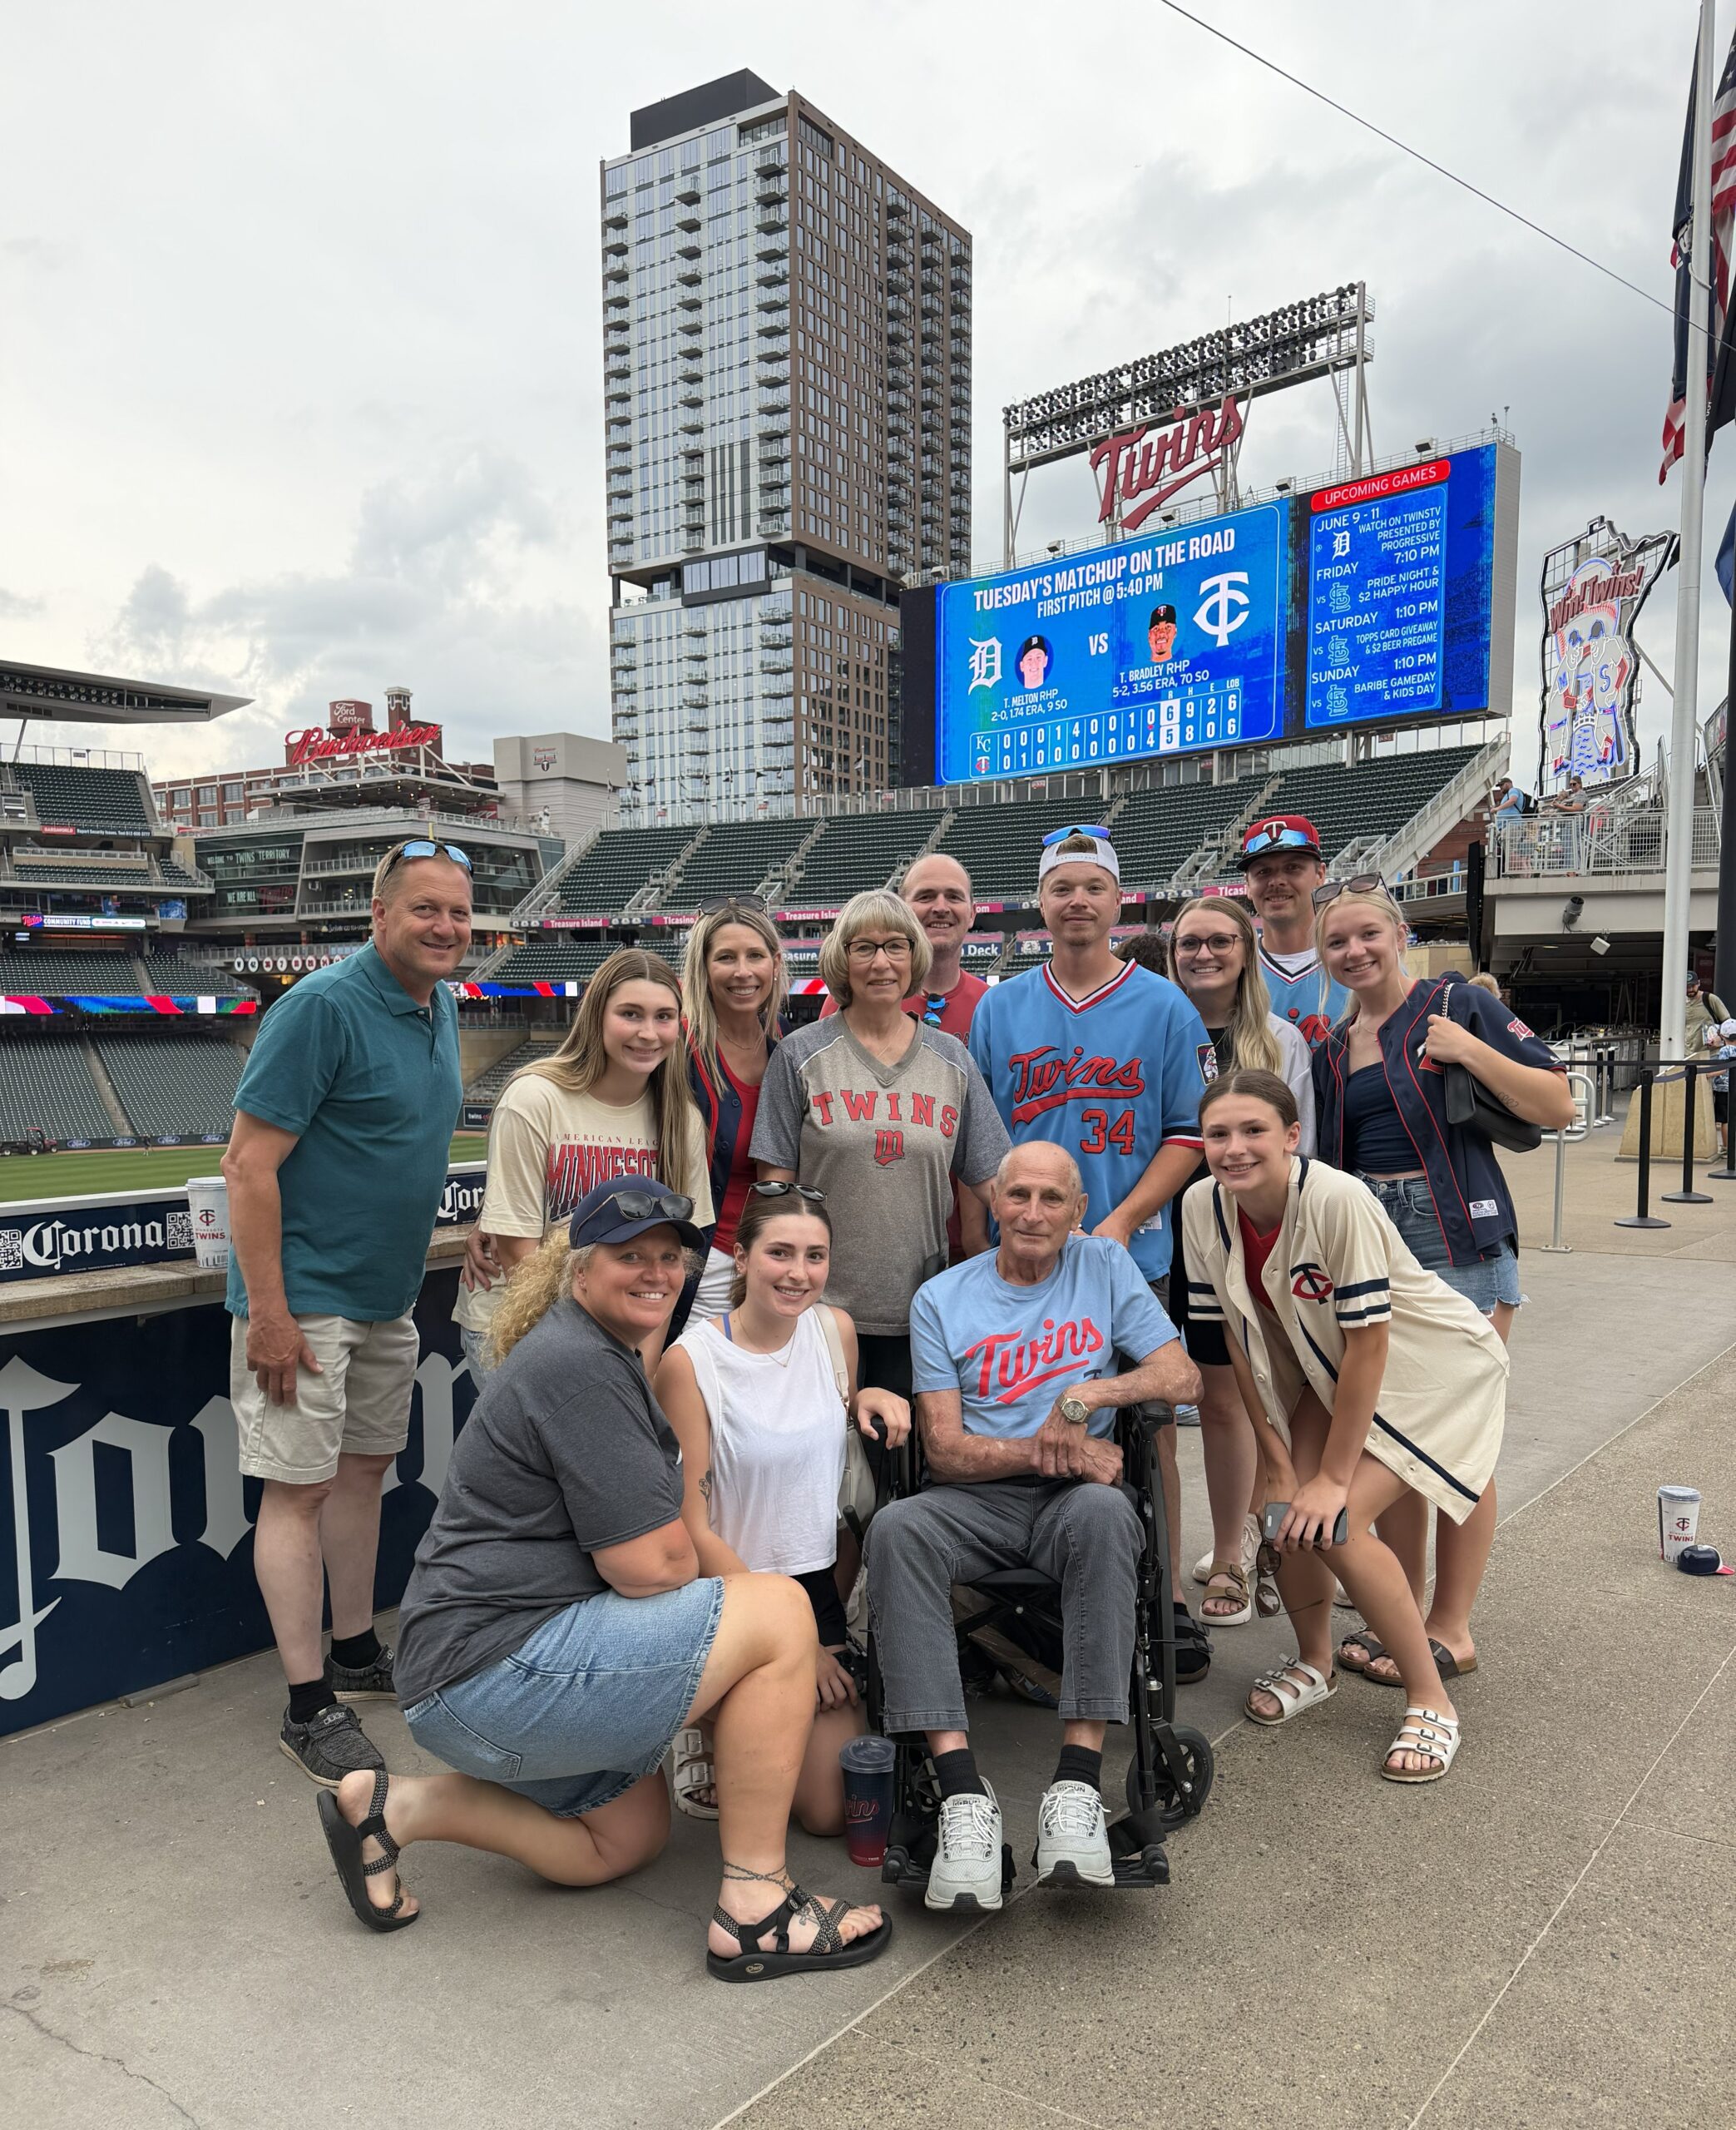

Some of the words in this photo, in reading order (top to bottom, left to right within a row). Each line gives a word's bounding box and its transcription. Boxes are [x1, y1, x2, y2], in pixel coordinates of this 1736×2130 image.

[1089, 394, 1243, 526] Twins
[1325, 478, 1389, 504] UPCOMING
[1392, 466, 1437, 488] GAMES
[1318, 514, 1349, 532] JUNE
[1352, 512, 1361, 524] 9
[1371, 507, 1379, 520] 11
[1358, 519, 1387, 534] WATCH
[1388, 516, 1401, 528] ON
[1402, 506, 1442, 523] TWINSTV
[1377, 523, 1427, 541] PRESENTED
[1429, 518, 1442, 528] BY
[1381, 530, 1441, 552] PROGRESSIVE
[1394, 549, 1417, 564] 7:10
[1421, 543, 1440, 559] PM
[973, 574, 1052, 612] TUESDAY'S
[1055, 554, 1126, 594] MATCHUP
[1130, 550, 1152, 575] ON
[1155, 541, 1187, 569] THE
[1189, 528, 1235, 561] ROAD
[1316, 561, 1359, 582] FRIDAY
[1368, 574, 1397, 589] PRIDE
[1399, 567, 1429, 582] NIGHT
[1432, 566, 1439, 576] &
[1036, 595, 1066, 619] FIRST
[1068, 587, 1100, 614] PITCH
[1102, 585, 1115, 606] @
[1116, 577, 1143, 599] 5:40
[1145, 572, 1163, 592] PM
[1358, 591, 1371, 603] $2
[1373, 584, 1407, 600] HAPPY
[1410, 577, 1439, 592] HOUR
[1585, 565, 1645, 606] Twins!
[1316, 596, 1326, 604] VS
[1396, 604, 1416, 619] 1:10
[1419, 599, 1438, 615] PM
[1315, 611, 1378, 634] SATURDAY
[1356, 632, 1379, 645] TOPPS
[1379, 627, 1400, 640] CARD
[1401, 621, 1438, 637] GIVEAWAY
[1088, 632, 1109, 656] VS
[1313, 646, 1323, 656] VS
[1365, 645, 1371, 654] &
[1372, 642, 1382, 654] $2
[1382, 639, 1402, 651] BEER
[1402, 632, 1437, 647] PREGAME
[1120, 671, 1127, 684] T.
[1129, 664, 1165, 682] BRADLEY
[1166, 659, 1189, 674] RHP
[1394, 656, 1414, 671] 1:10
[1417, 651, 1437, 666] PM
[1113, 686, 1130, 698] 5-2,
[1131, 681, 1153, 694] 3.56
[1155, 677, 1178, 690] ERA,
[1180, 672, 1193, 686] 70
[1194, 669, 1209, 681] SO
[1311, 665, 1360, 684] SUNDAY
[1354, 679, 1388, 694] BARIBE
[1391, 671, 1437, 686] GAMEDAY
[1003, 697, 1011, 709] T.
[1011, 692, 1038, 708] MELTON
[1040, 688, 1058, 701] RHP
[1168, 691, 1173, 699] R
[1188, 687, 1193, 696] H
[1209, 682, 1214, 692] E
[1226, 678, 1239, 689] LOB
[1384, 691, 1391, 701] &
[1392, 686, 1415, 699] KIDS
[1417, 682, 1437, 696] DAY
[334, 702, 355, 716] Ford
[992, 709, 1008, 722] 2-0,
[1010, 707, 1025, 720] 1.74
[1025, 703, 1046, 716] ERA,
[1046, 701, 1053, 712] 9
[1055, 699, 1068, 710] SO
[1311, 699, 1323, 708] VS
[337, 715, 366, 725] Center
[1003, 734, 1011, 749] 0
[1020, 731, 1028, 746] 0
[1036, 728, 1045, 744] 0
[1056, 726, 1061, 741] 1
[1072, 721, 1080, 737] 4
[1090, 719, 1098, 734] 0
[1108, 716, 1116, 732] 0
[1129, 712, 1135, 728] 1
[1146, 709, 1155, 726] 0
[1166, 706, 1174, 722] 6
[1186, 702, 1194, 719] 9
[1207, 697, 1216, 714] 2
[1228, 694, 1237, 711] 6
[284, 720, 440, 765] Budweiser
[1003, 755, 1011, 770] 0
[1021, 752, 1026, 767] 1
[1036, 750, 1045, 765] 0
[1054, 747, 1061, 762] 0
[1071, 744, 1080, 760] 0
[1090, 741, 1098, 757] 0
[1108, 737, 1116, 754] 0
[1127, 734, 1135, 750] 0
[1146, 731, 1155, 747] 4
[1166, 729, 1174, 744] 5
[1185, 726, 1194, 742] 8
[1206, 721, 1216, 739] 0
[1227, 717, 1236, 736] 6
[235, 852, 255, 864] TWINS
[258, 849, 290, 860] TERRITORY
[226, 892, 235, 904] WE
[236, 891, 246, 903] ARE
[246, 890, 256, 902] ALL
[581, 919, 602, 927] Island
[784, 912, 820, 921] Treasure
[821, 910, 841, 919] Islan
[968, 944, 998, 956] Deck
[1008, 1045, 1145, 1104] Twins
[812, 1089, 958, 1137] TWINS
[556, 1133, 622, 1144] AMERICAN
[1080, 1108, 1135, 1155] 34
[546, 1144, 659, 1223] MINNESOT
[438, 1181, 485, 1221] Cor
[22, 1220, 166, 1270] Corona
[965, 1317, 1105, 1399] Twins
